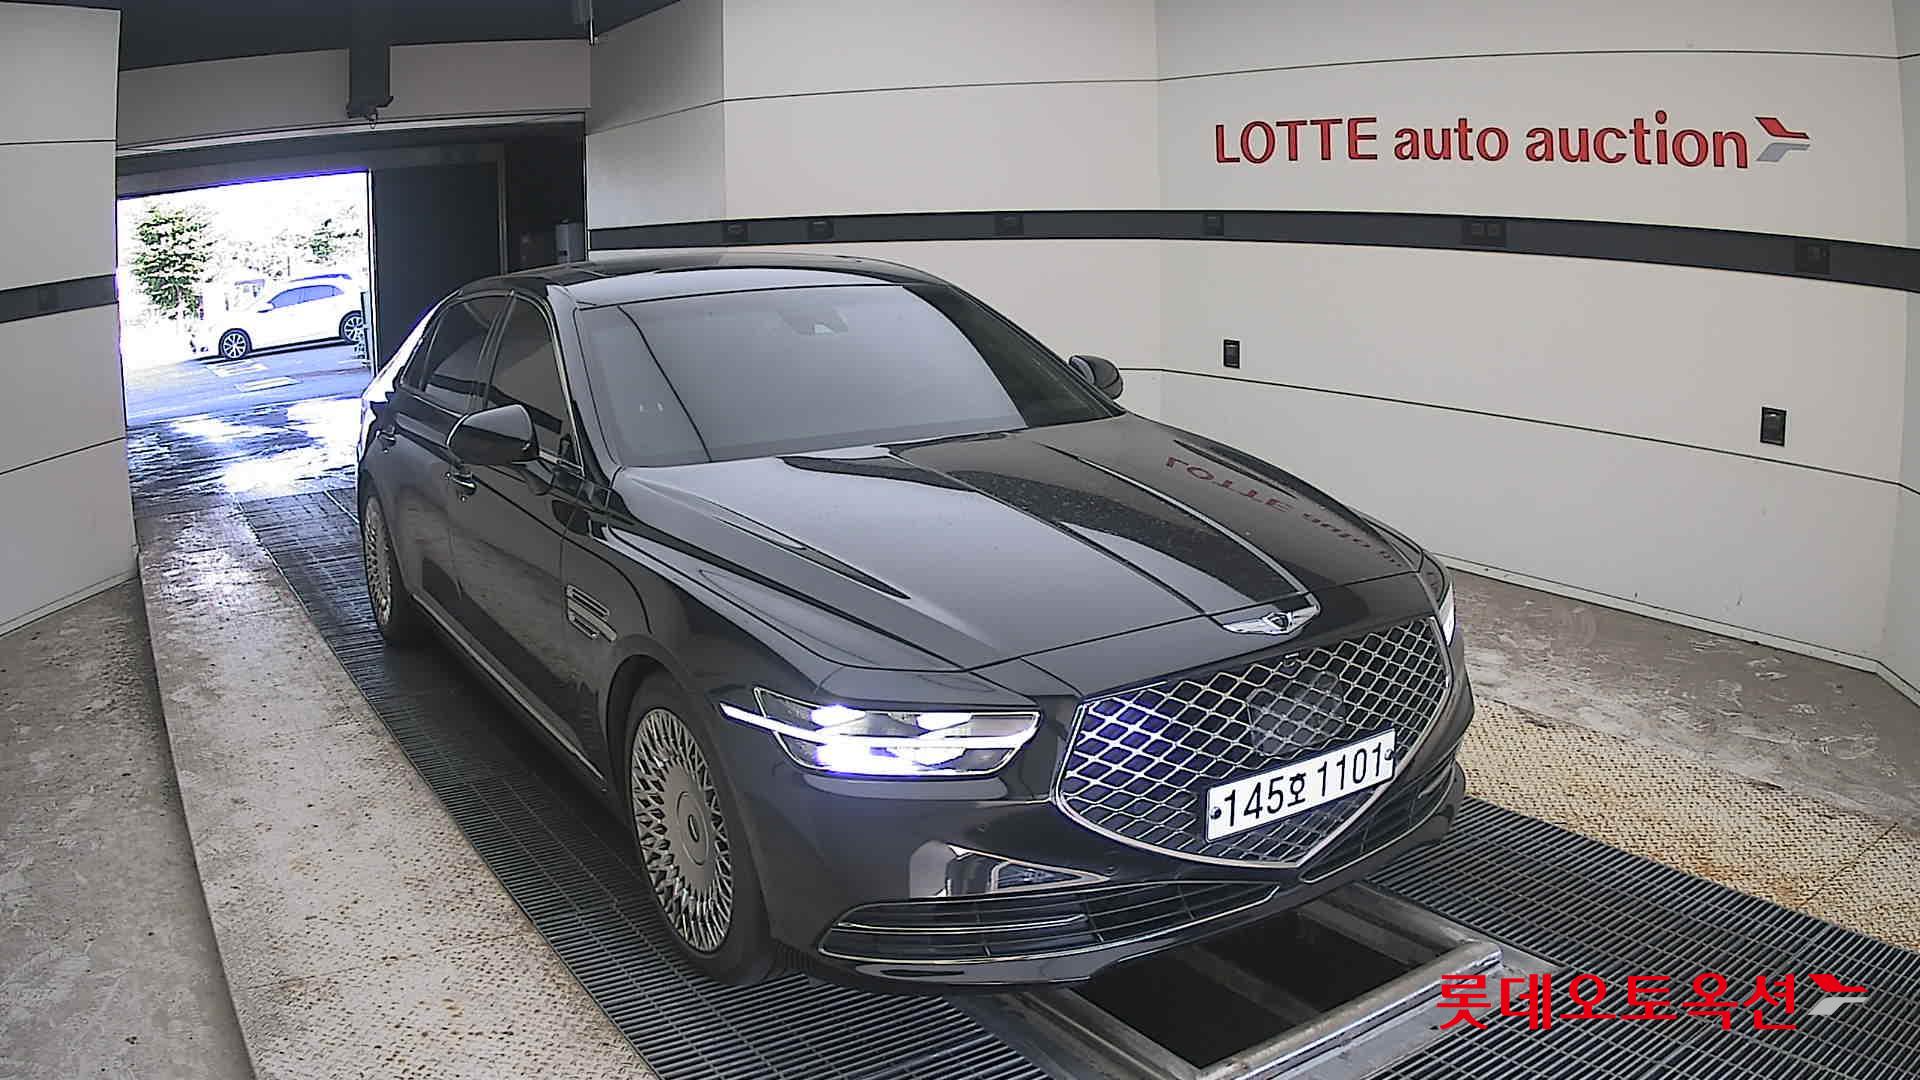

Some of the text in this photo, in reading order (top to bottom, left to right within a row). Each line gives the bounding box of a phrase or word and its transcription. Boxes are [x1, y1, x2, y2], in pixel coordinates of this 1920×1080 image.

[1215, 110, 1749, 169] LOTTE auto auction
[1224, 741, 1382, 827] 145호 1101
